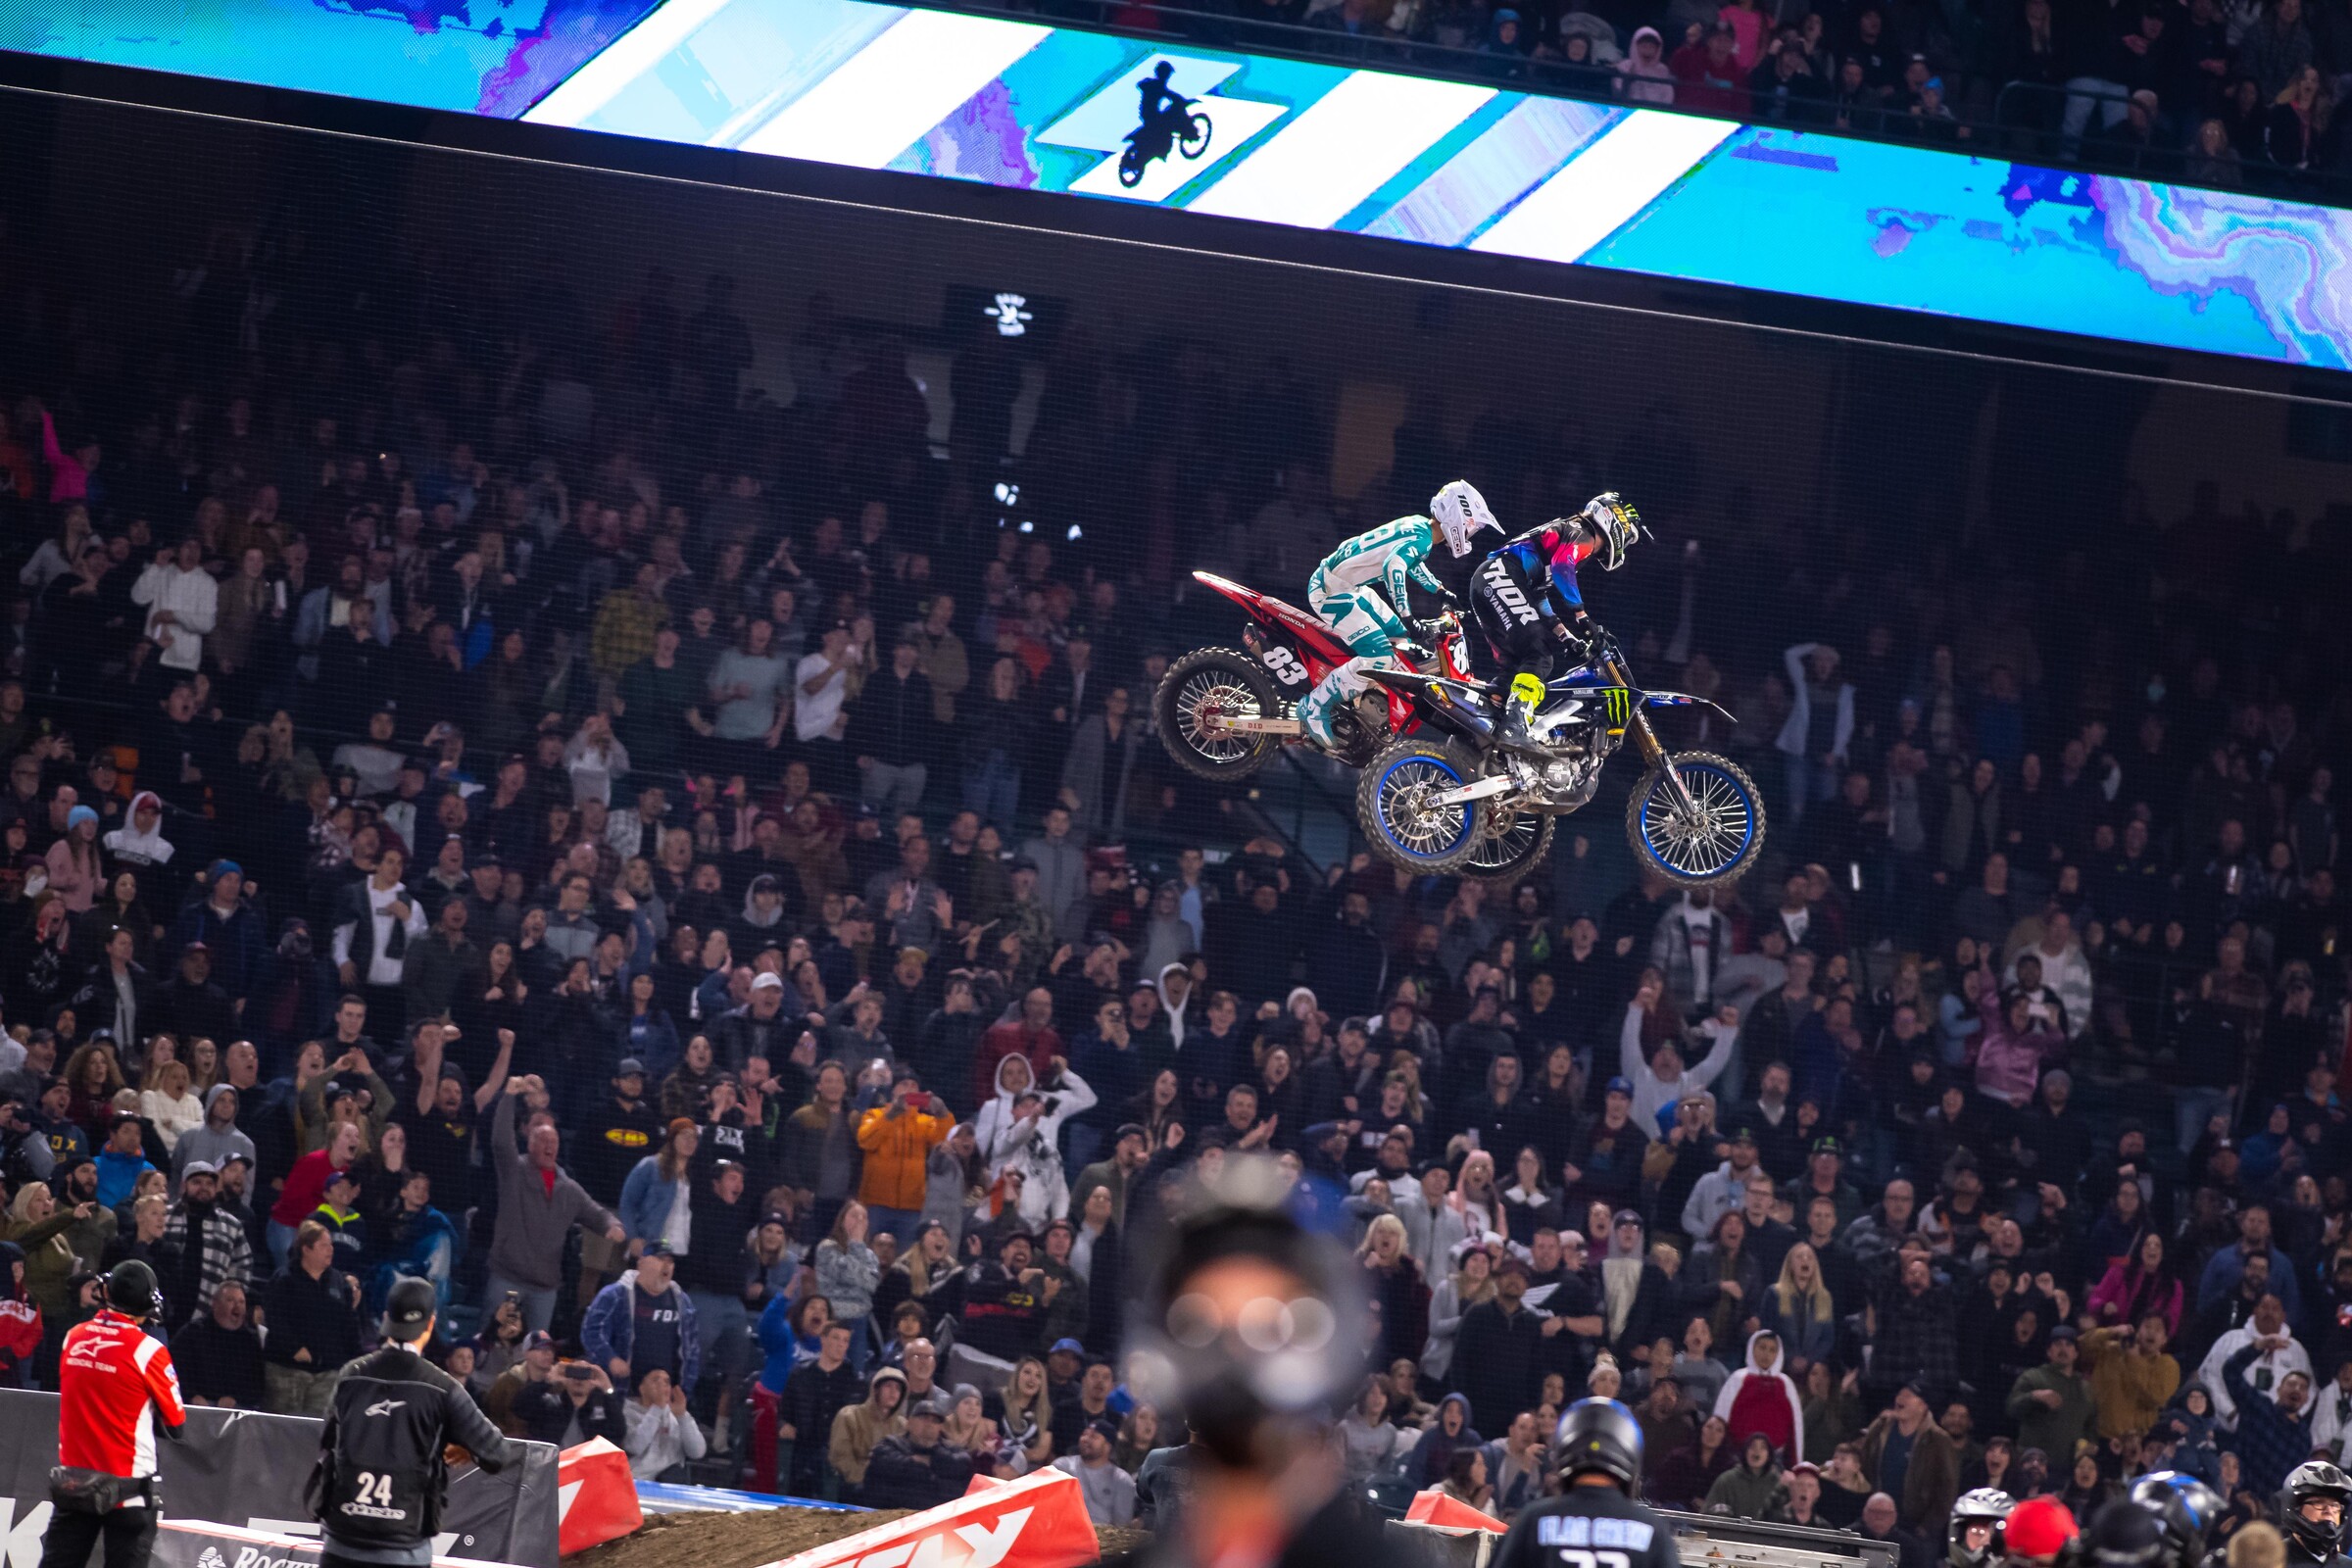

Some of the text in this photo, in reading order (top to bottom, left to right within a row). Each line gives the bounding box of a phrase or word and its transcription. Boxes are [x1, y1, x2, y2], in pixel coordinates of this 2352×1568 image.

[1483, 557, 1541, 626] THOR
[1277, 612, 1306, 630] HONDA
[1489, 594, 1513, 631] YAMAHA
[1263, 646, 1309, 686] 83
[66, 1357, 117, 1374] MEDICAL TEAM
[355, 1471, 392, 1507] 24
